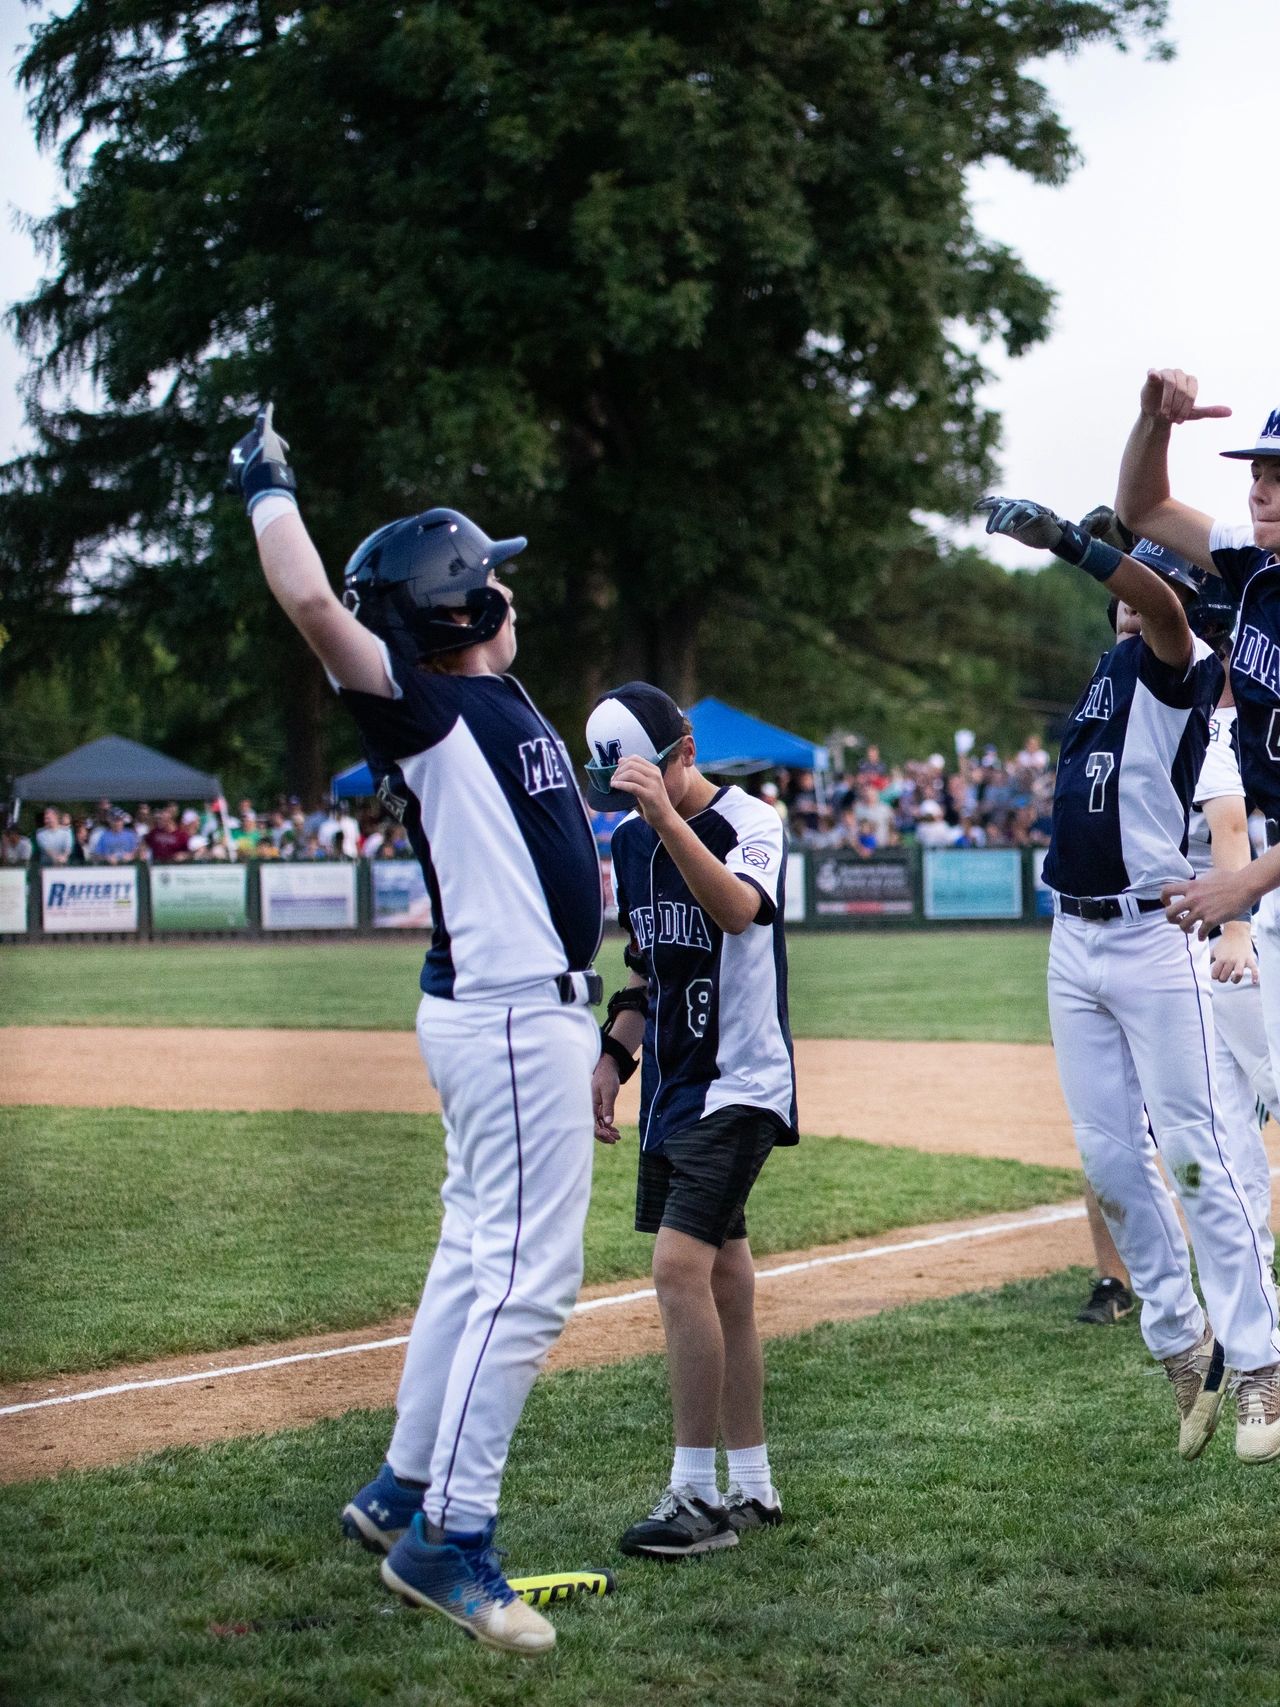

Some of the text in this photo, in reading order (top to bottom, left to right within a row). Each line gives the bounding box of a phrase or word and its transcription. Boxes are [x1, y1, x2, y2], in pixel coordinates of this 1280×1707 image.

[595, 738, 623, 767] M
[1085, 752, 1115, 813] 7
[685, 978, 714, 1038] 8
